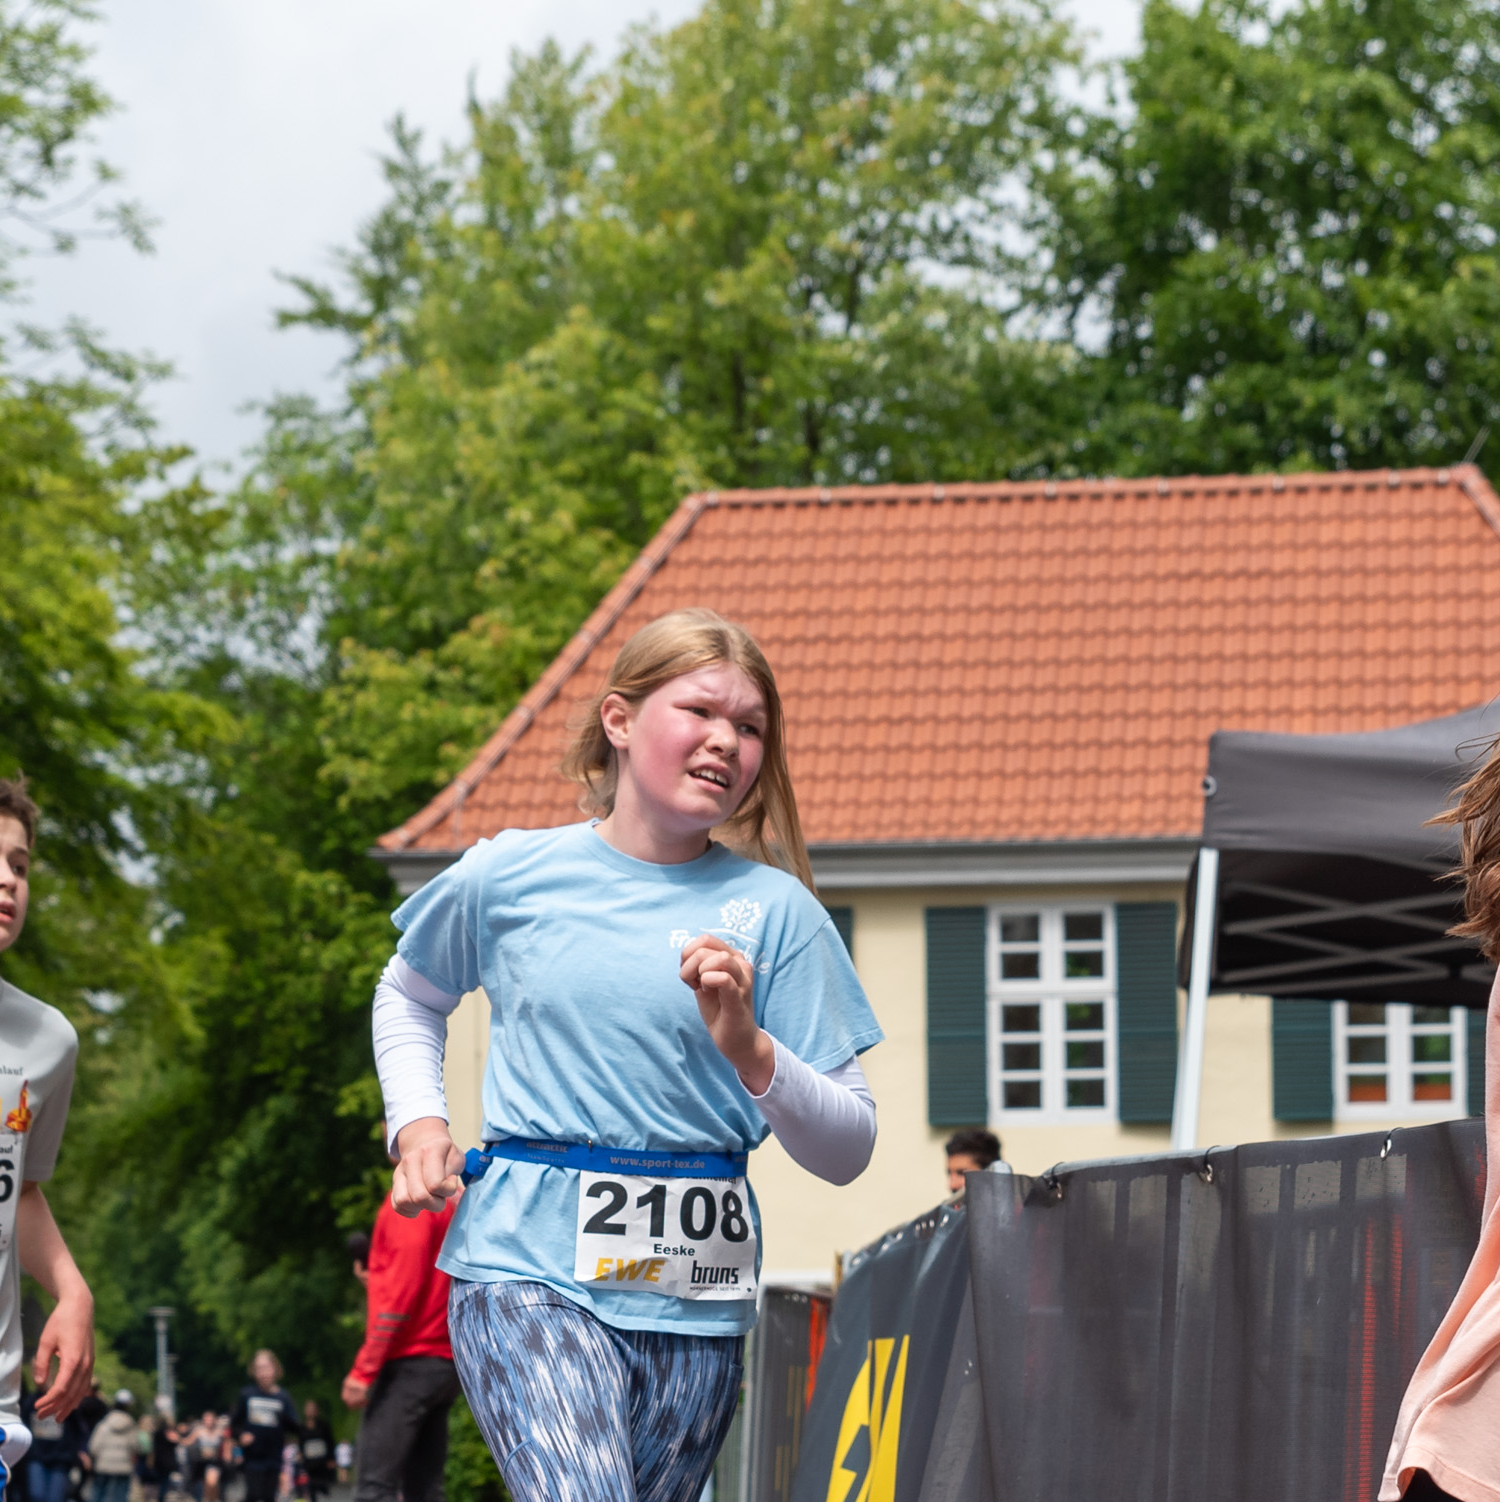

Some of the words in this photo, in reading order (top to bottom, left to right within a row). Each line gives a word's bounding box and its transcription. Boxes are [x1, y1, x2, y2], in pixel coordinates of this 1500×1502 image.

[609, 1155, 706, 1170] www.sport-tex.de
[582, 1180, 749, 1244] 2108
[653, 1243, 696, 1257] Eeske
[593, 1256, 666, 1283] EWE
[690, 1259, 740, 1285] bruns
